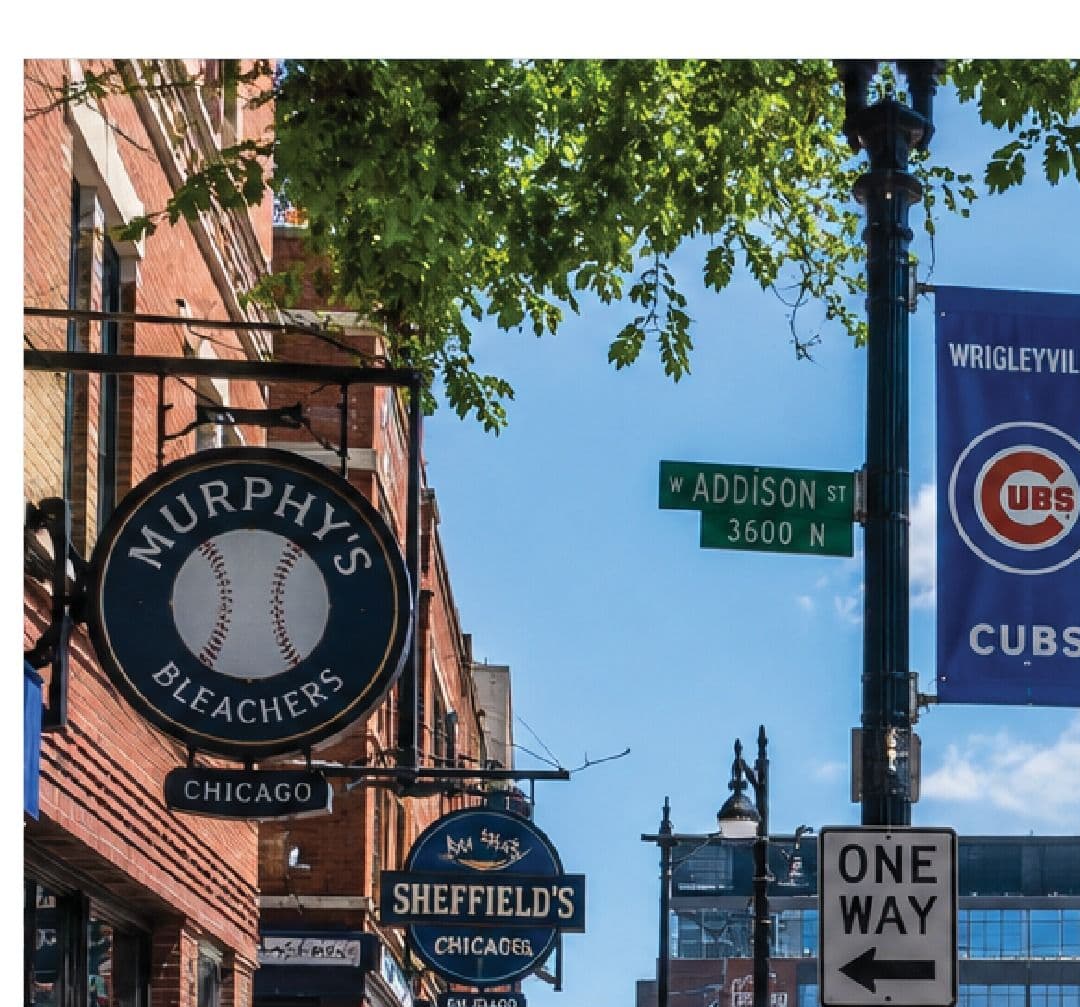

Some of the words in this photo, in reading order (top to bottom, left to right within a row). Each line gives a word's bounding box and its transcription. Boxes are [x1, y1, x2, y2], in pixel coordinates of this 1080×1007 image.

[670, 476, 683, 493] W
[692, 470, 816, 510] ADDISON
[827, 485, 847, 502] ST
[980, 449, 1076, 547] CUBS
[128, 476, 372, 576] MURPHY'S
[727, 519, 792, 545] 3600
[810, 523, 825, 547] N
[151, 661, 344, 725] BLEACHERS
[184, 780, 312, 803] CHICAGO
[838, 843, 938, 884] ONE
[392, 882, 575, 919] SHEFFIELD'S
[838, 895, 938, 935] WAY
